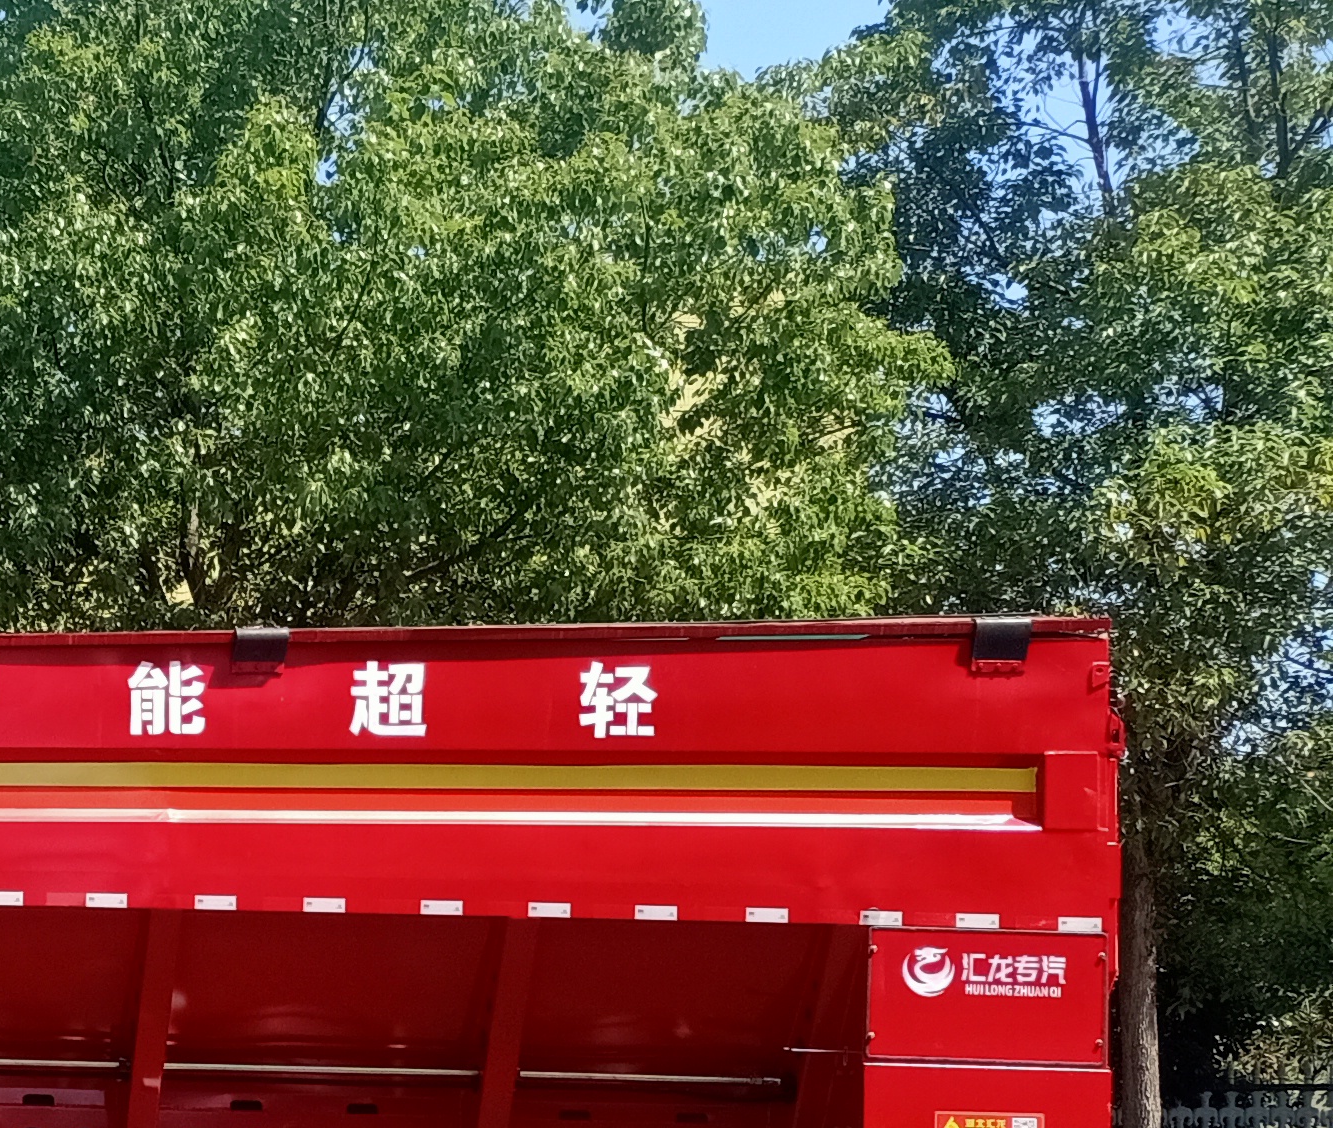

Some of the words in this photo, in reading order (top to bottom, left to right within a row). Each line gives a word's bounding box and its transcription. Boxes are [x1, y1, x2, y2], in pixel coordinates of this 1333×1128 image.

[961, 953, 1067, 984] 汇龙专汽
[965, 984, 984, 995] HUI
[985, 984, 1013, 996] LONG
[1014, 985, 1049, 997] ZHUAN
[1050, 986, 1062, 998] QI
